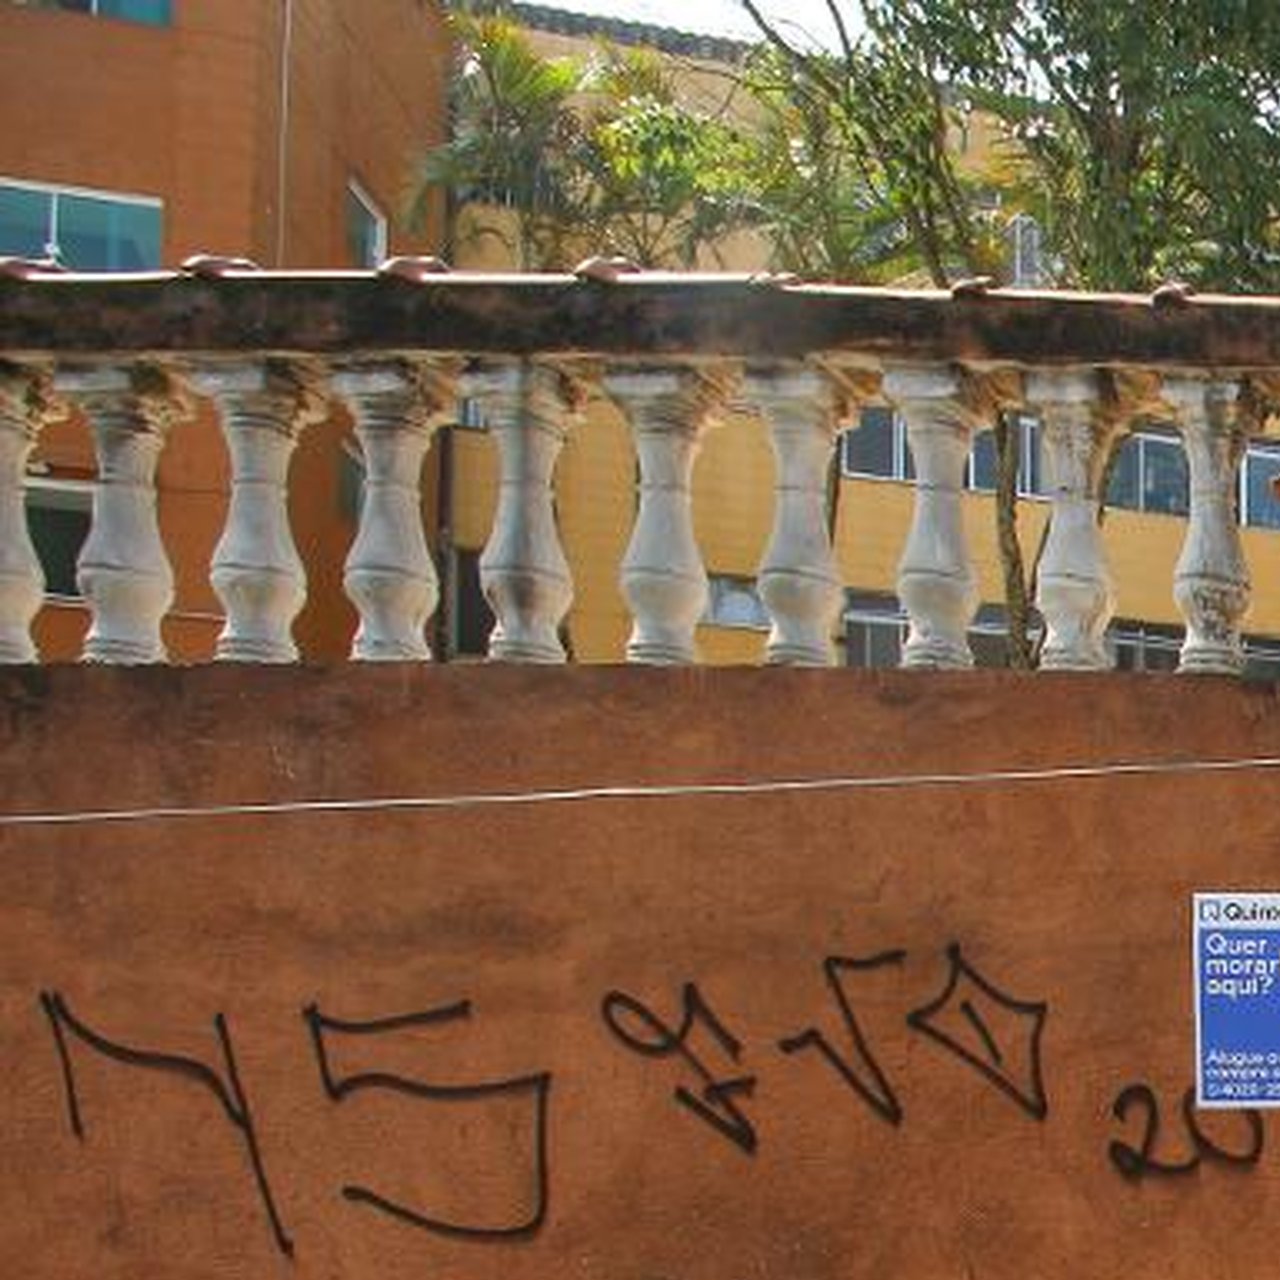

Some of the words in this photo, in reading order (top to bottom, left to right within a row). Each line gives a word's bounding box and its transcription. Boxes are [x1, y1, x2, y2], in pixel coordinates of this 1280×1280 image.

[1205, 932, 1268, 955] Quer
[1205, 958, 1280, 974] morar
[1205, 976, 1274, 997] aqui?
